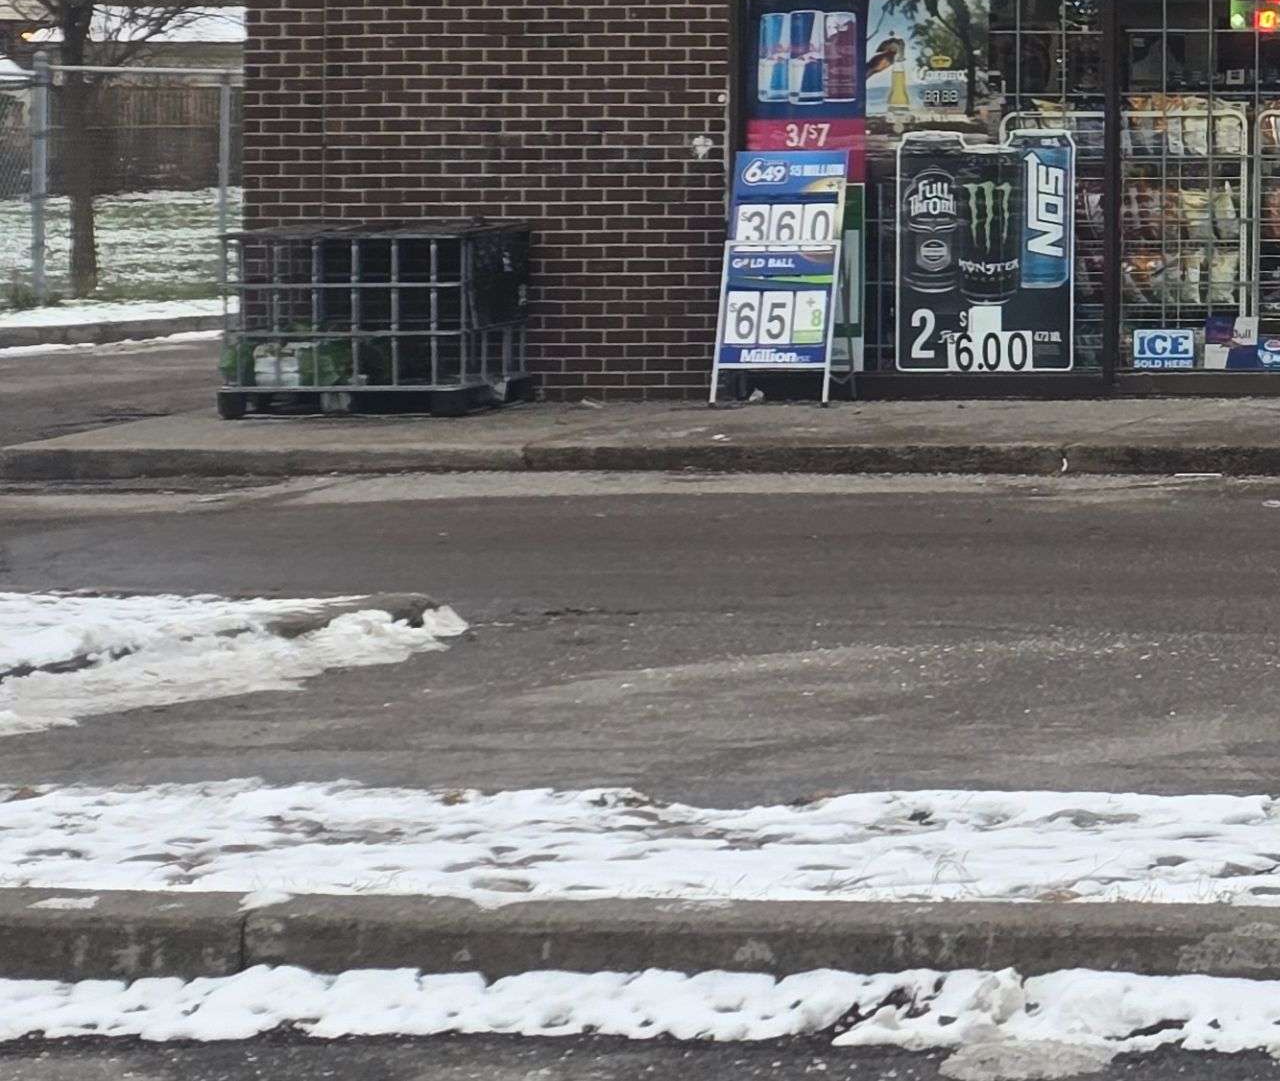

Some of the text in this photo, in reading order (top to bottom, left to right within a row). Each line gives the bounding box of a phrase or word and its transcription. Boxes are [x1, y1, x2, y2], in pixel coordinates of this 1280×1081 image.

[786, 123, 831, 148] 3/$7
[744, 160, 787, 183] 649
[1027, 164, 1065, 258] NOS
[911, 308, 936, 359] 2
[1137, 334, 1190, 355] ICE
[740, 348, 797, 363] Million
[1133, 359, 1193, 369] SOLD HERE
